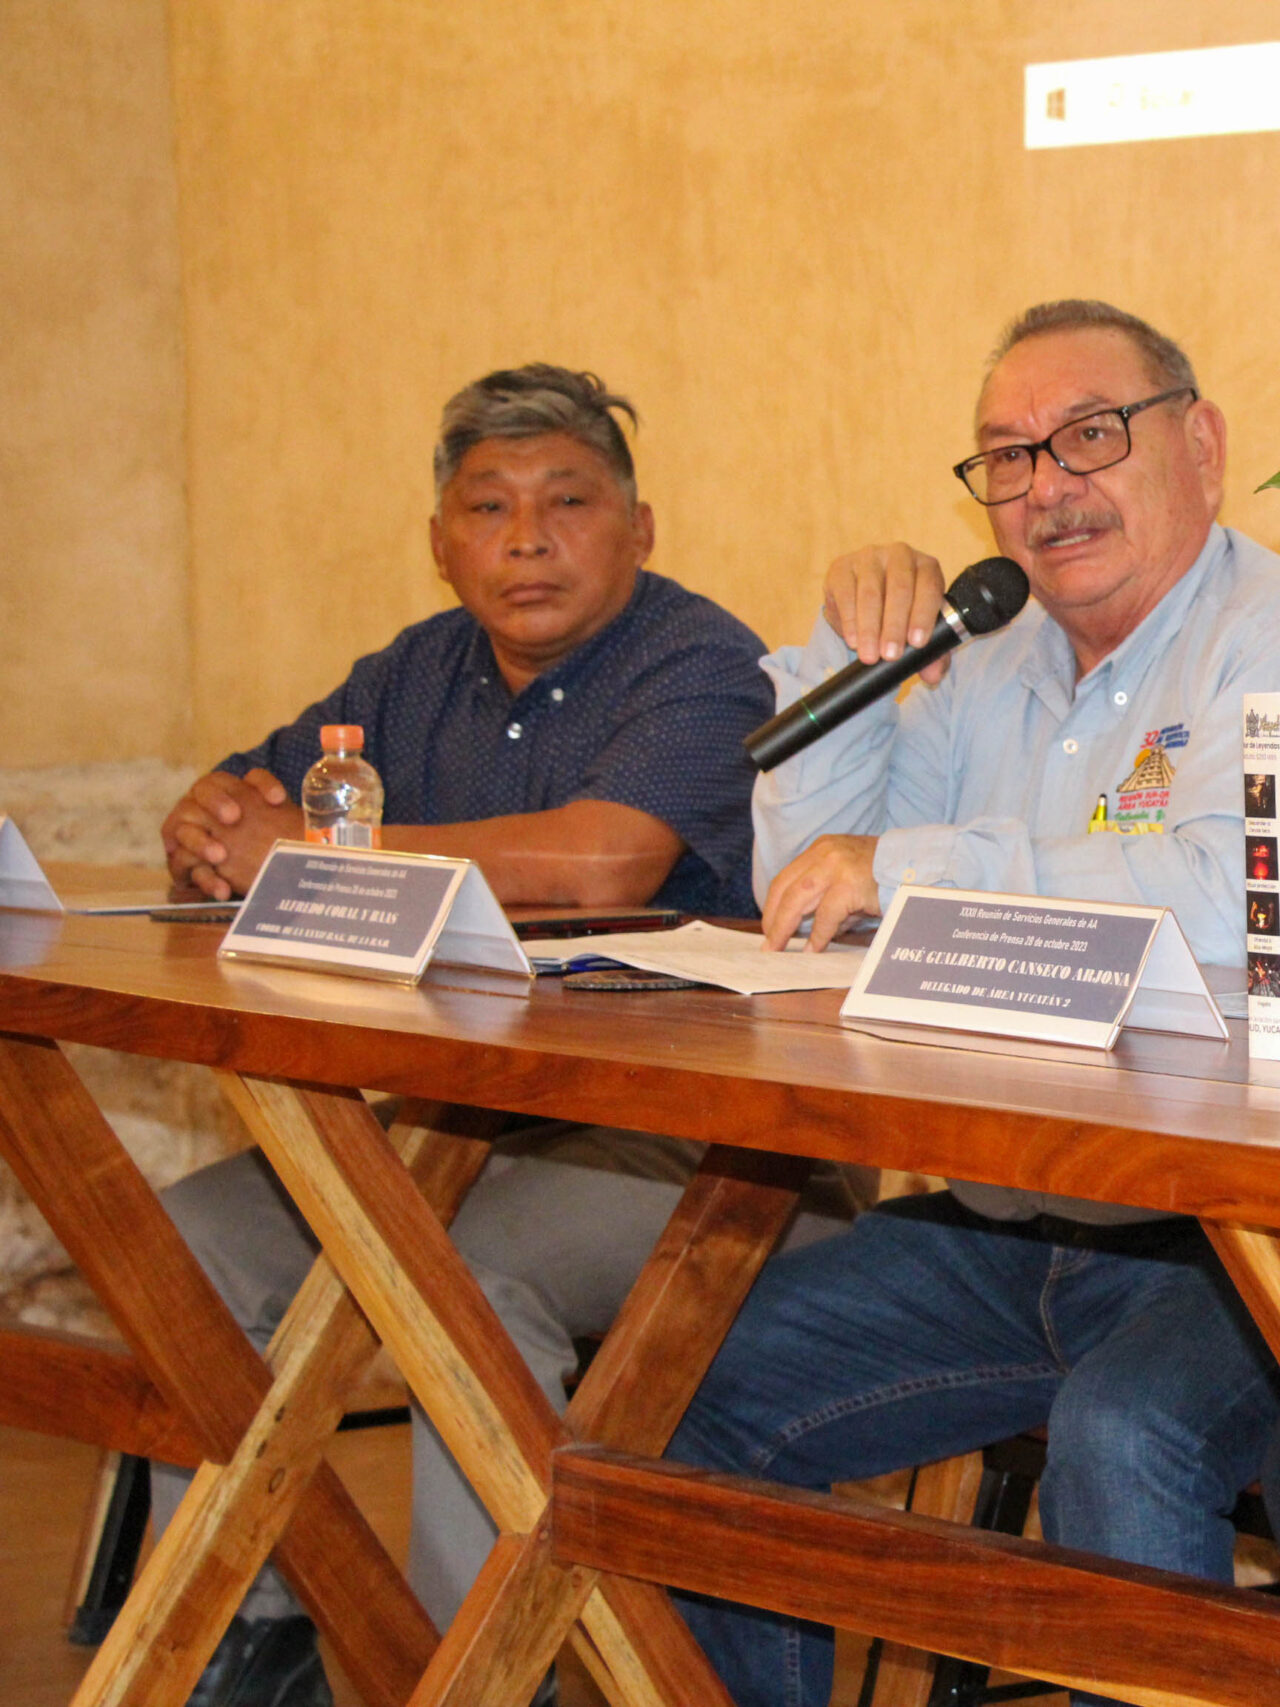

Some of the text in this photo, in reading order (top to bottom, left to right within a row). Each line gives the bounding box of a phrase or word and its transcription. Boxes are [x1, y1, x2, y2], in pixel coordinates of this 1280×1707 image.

[977, 908, 1003, 920] Reunión
[1002, 910, 1012, 921] de
[1012, 911, 1043, 924] Servicios
[1043, 914, 1077, 928] Generales
[1077, 917, 1086, 928] de
[1086, 919, 1098, 930] AA
[952, 928, 990, 941] Conferencia
[989, 931, 999, 942] de
[1000, 932, 1024, 945] Prensa
[1034, 937, 1043, 947] de
[1043, 939, 1070, 950] octubre
[890, 946, 1130, 987] JOSÉ GUALBERTO CANSECO ARJONA
[920, 980, 971, 995] DELEGADO
[971, 986, 987, 997] DE
